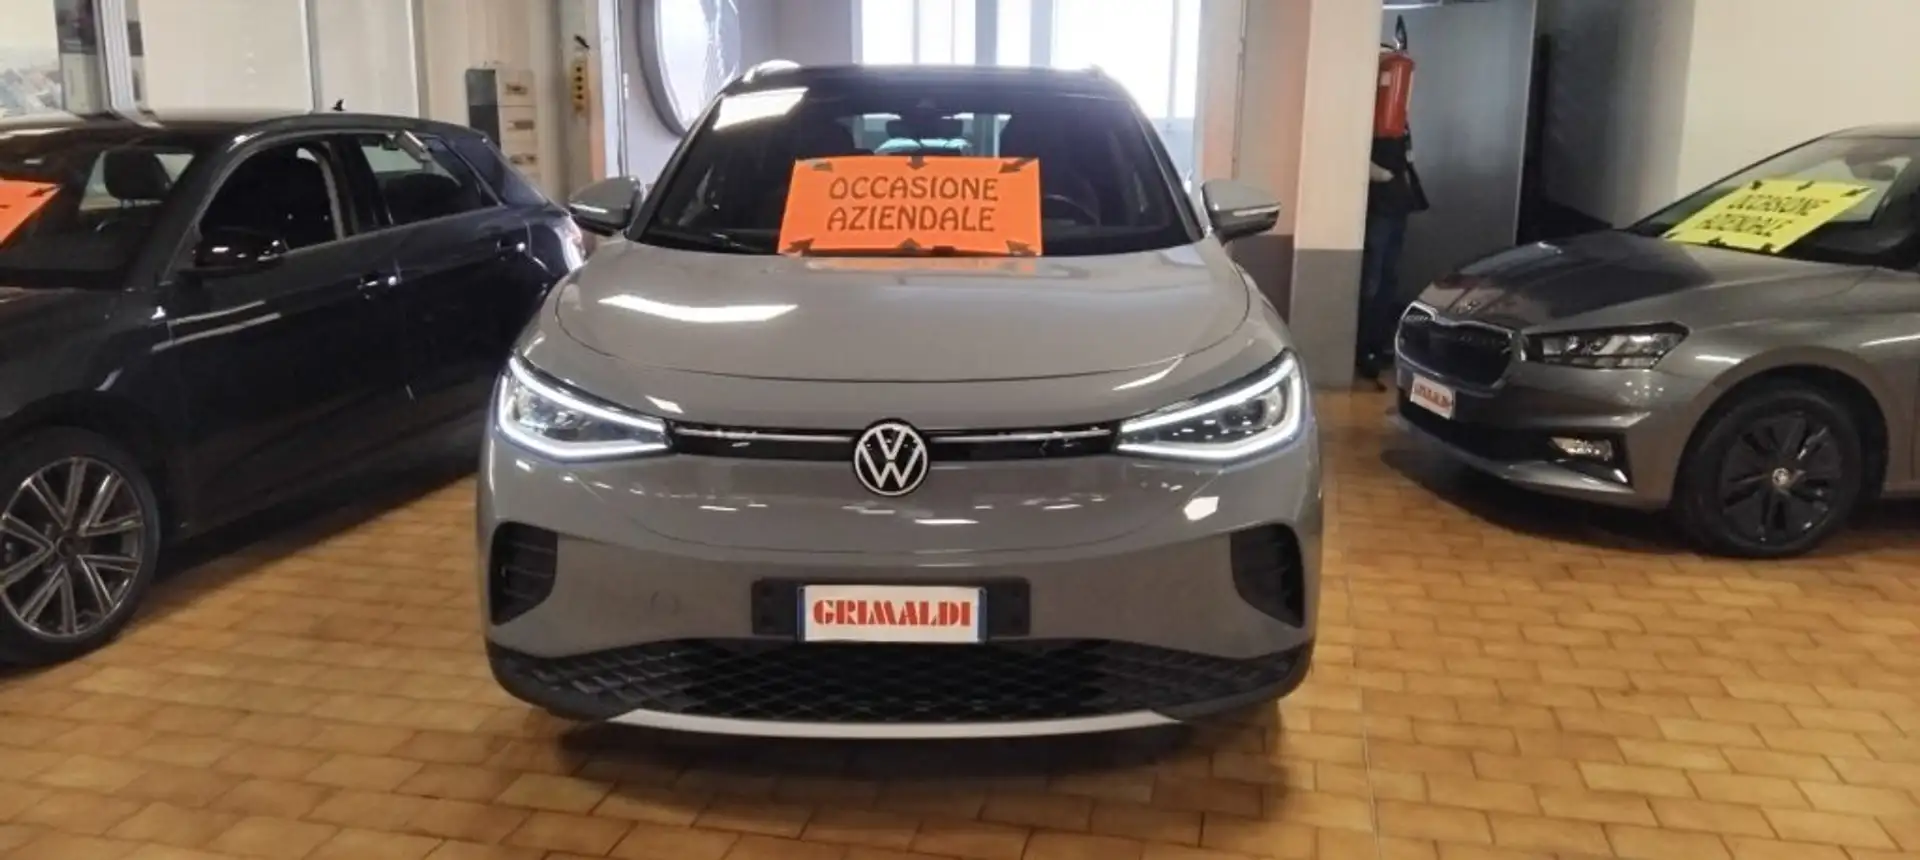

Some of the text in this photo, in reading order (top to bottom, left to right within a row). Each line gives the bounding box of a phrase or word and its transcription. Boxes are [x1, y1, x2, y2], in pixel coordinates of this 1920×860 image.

[828, 175, 999, 202] OCCASIONE
[826, 205, 996, 232] AZIENDALE
[812, 599, 972, 627] GRIMALDI
